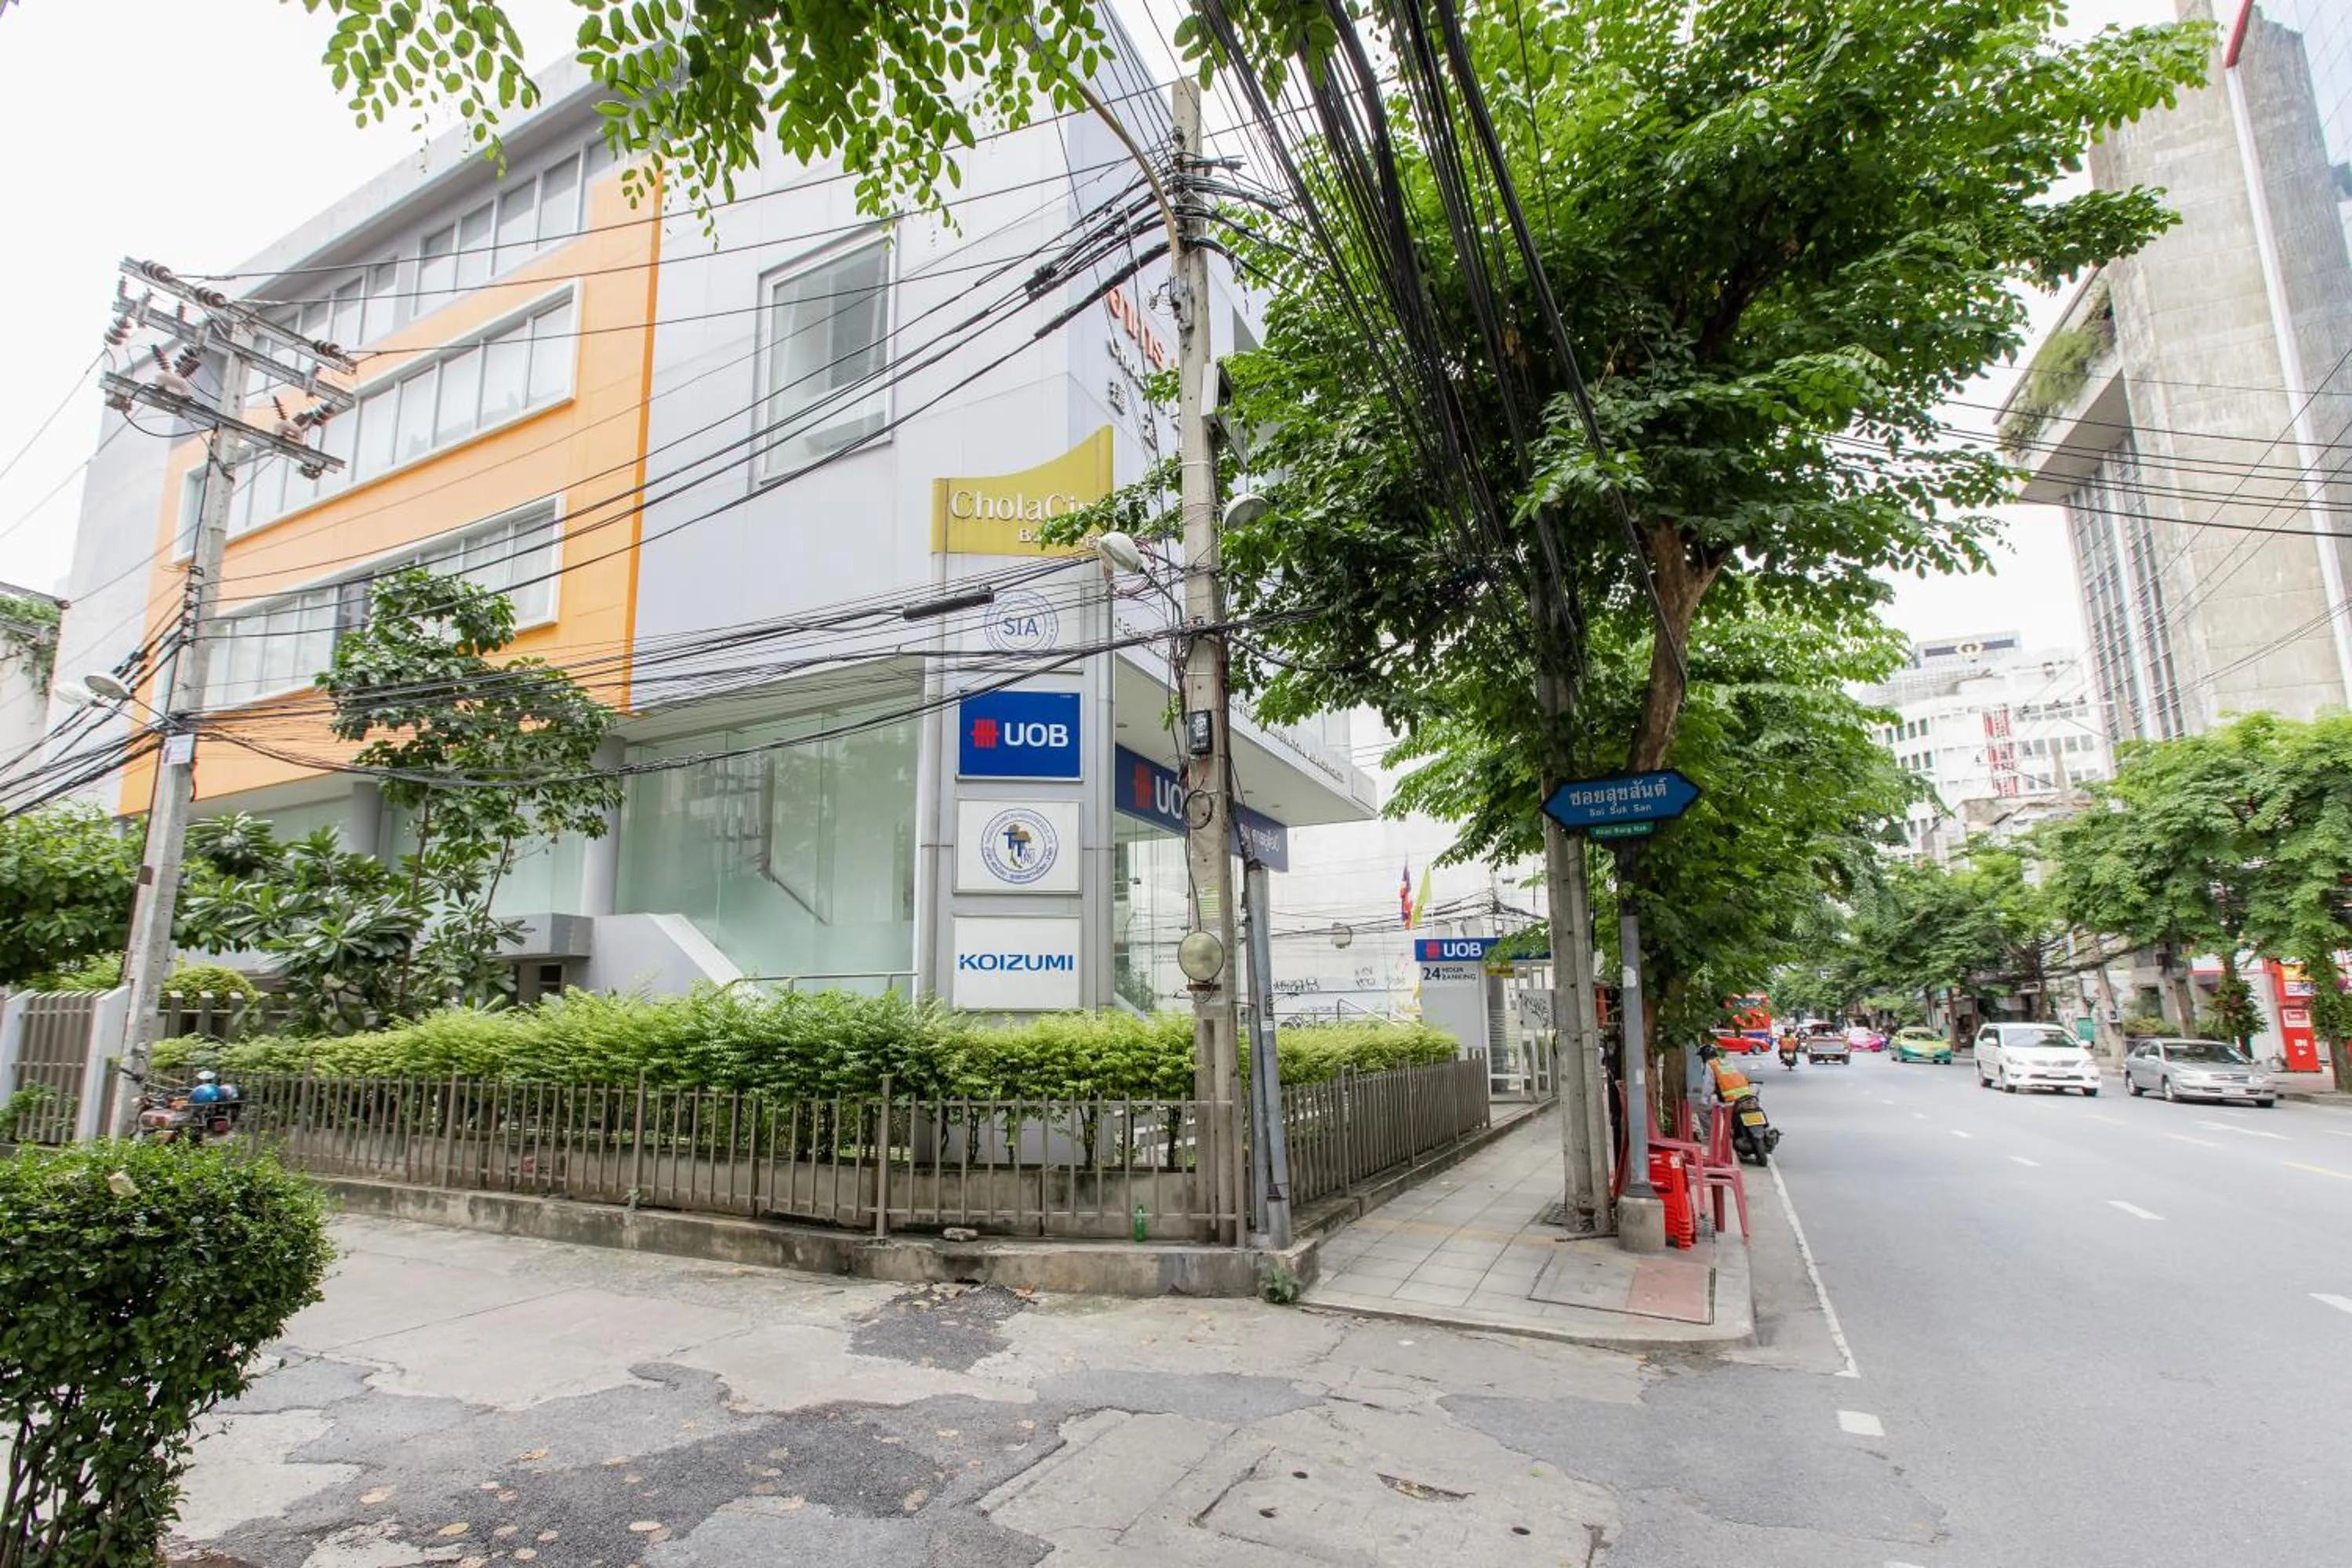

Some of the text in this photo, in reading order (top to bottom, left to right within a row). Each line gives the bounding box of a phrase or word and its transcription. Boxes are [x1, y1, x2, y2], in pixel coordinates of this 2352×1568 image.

[1003, 617, 1039, 636] SIA
[1004, 722, 1069, 747] UOB
[1155, 775, 1185, 821] UO
[1570, 777, 1667, 807] ซอยสุขสันต์
[1589, 804, 1652, 817] Soi Suk San
[1443, 942, 1483, 957] UOB
[959, 953, 1074, 971] KOIZUMI
[1423, 967, 1441, 981] 24
